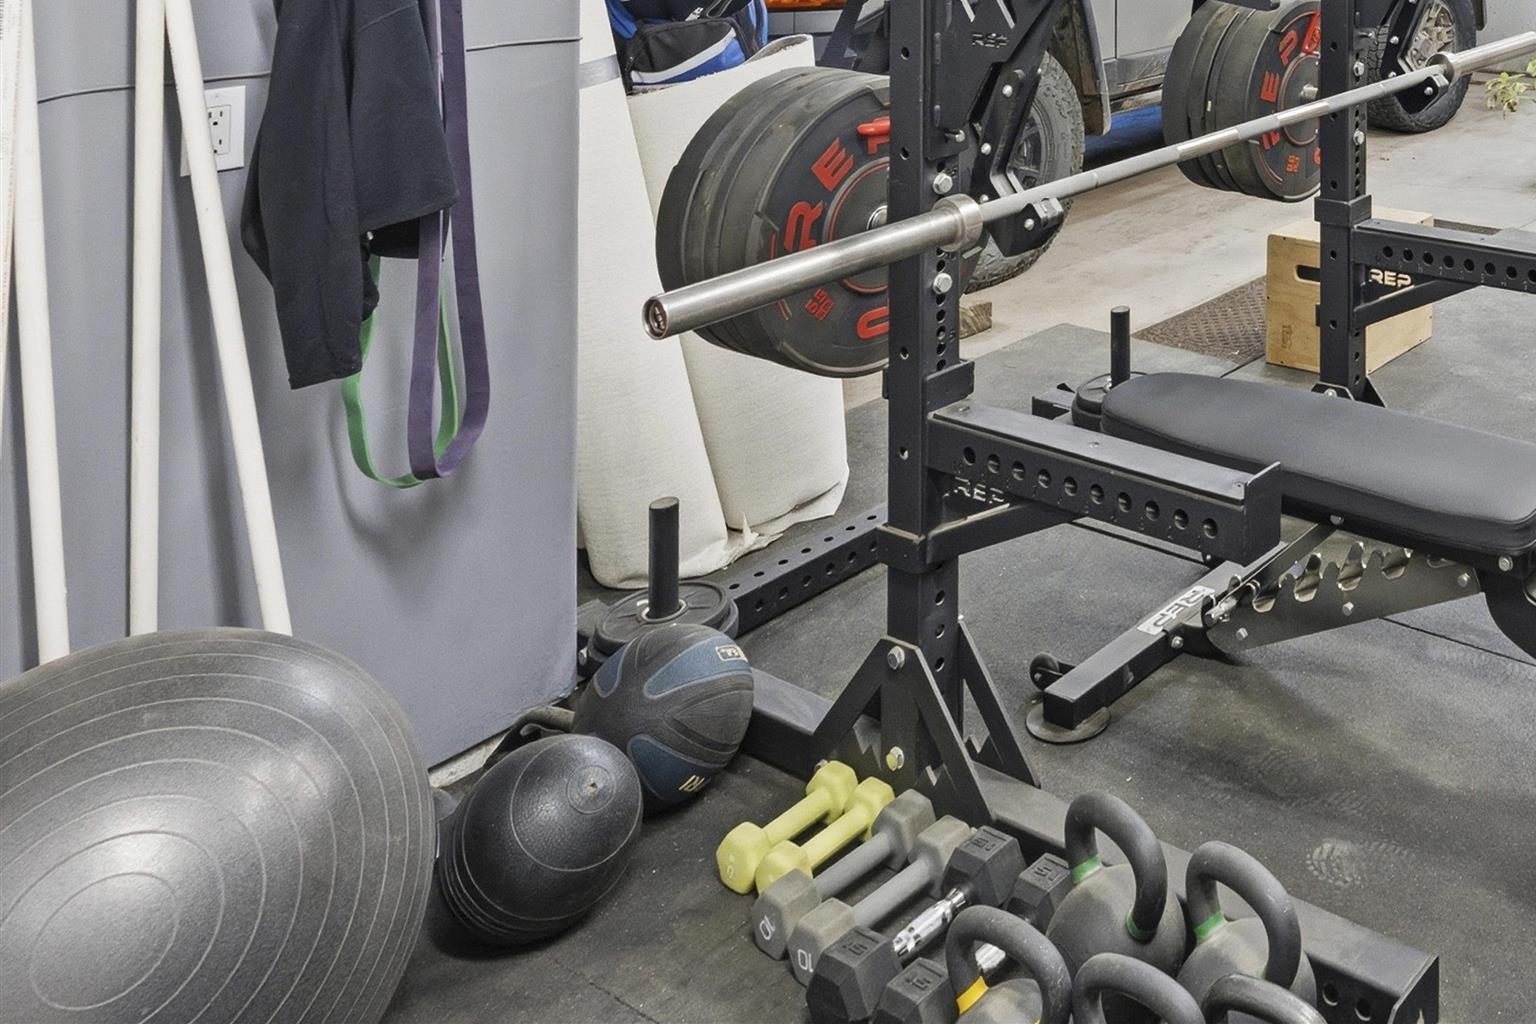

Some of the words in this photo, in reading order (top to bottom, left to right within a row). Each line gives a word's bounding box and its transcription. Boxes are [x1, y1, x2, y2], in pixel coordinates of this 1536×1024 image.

[1368, 268, 1412, 288] REP
[953, 476, 1005, 505] REP
[797, 948, 814, 973] 10
